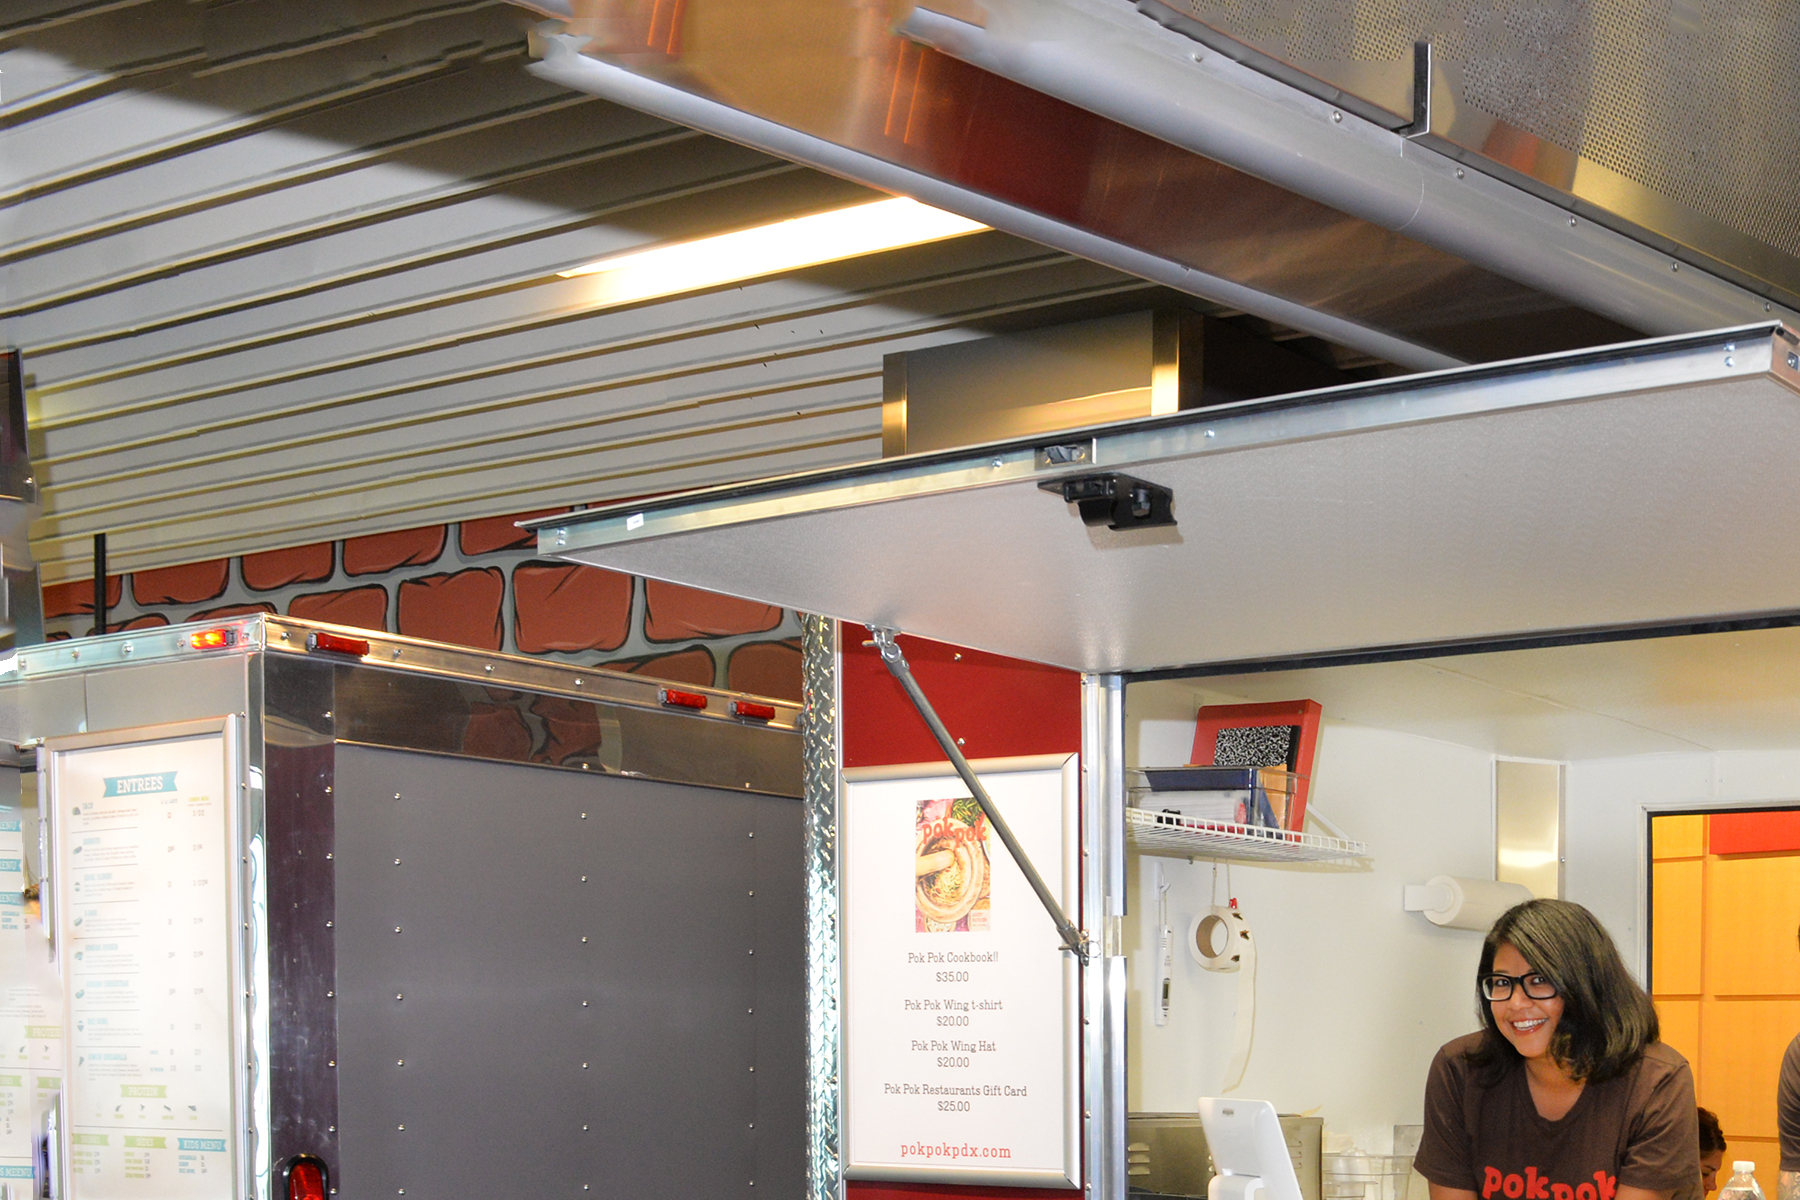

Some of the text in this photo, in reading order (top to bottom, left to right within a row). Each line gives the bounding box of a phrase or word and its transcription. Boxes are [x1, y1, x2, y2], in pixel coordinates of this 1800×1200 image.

[116, 776, 164, 794] ENTREES
[908, 952, 925, 963] Pok
[927, 952, 945, 962] Pok
[936, 971, 968, 982] $35.00
[904, 999, 1002, 1011] Pok Pok Wing t-shirt
[937, 1015, 969, 1026] $20.00
[911, 1040, 996, 1053] Pok Pok Wing Hat
[937, 1056, 969, 1067] $20.00
[128, 1087, 158, 1096] PROTEIN
[884, 1083, 1027, 1096] Pok Pok Restaurants Gift Card
[937, 1100, 970, 1112] $25.00
[183, 1140, 222, 1150] KIDS MENU
[901, 1141, 1011, 1159] pokpokpdx.com
